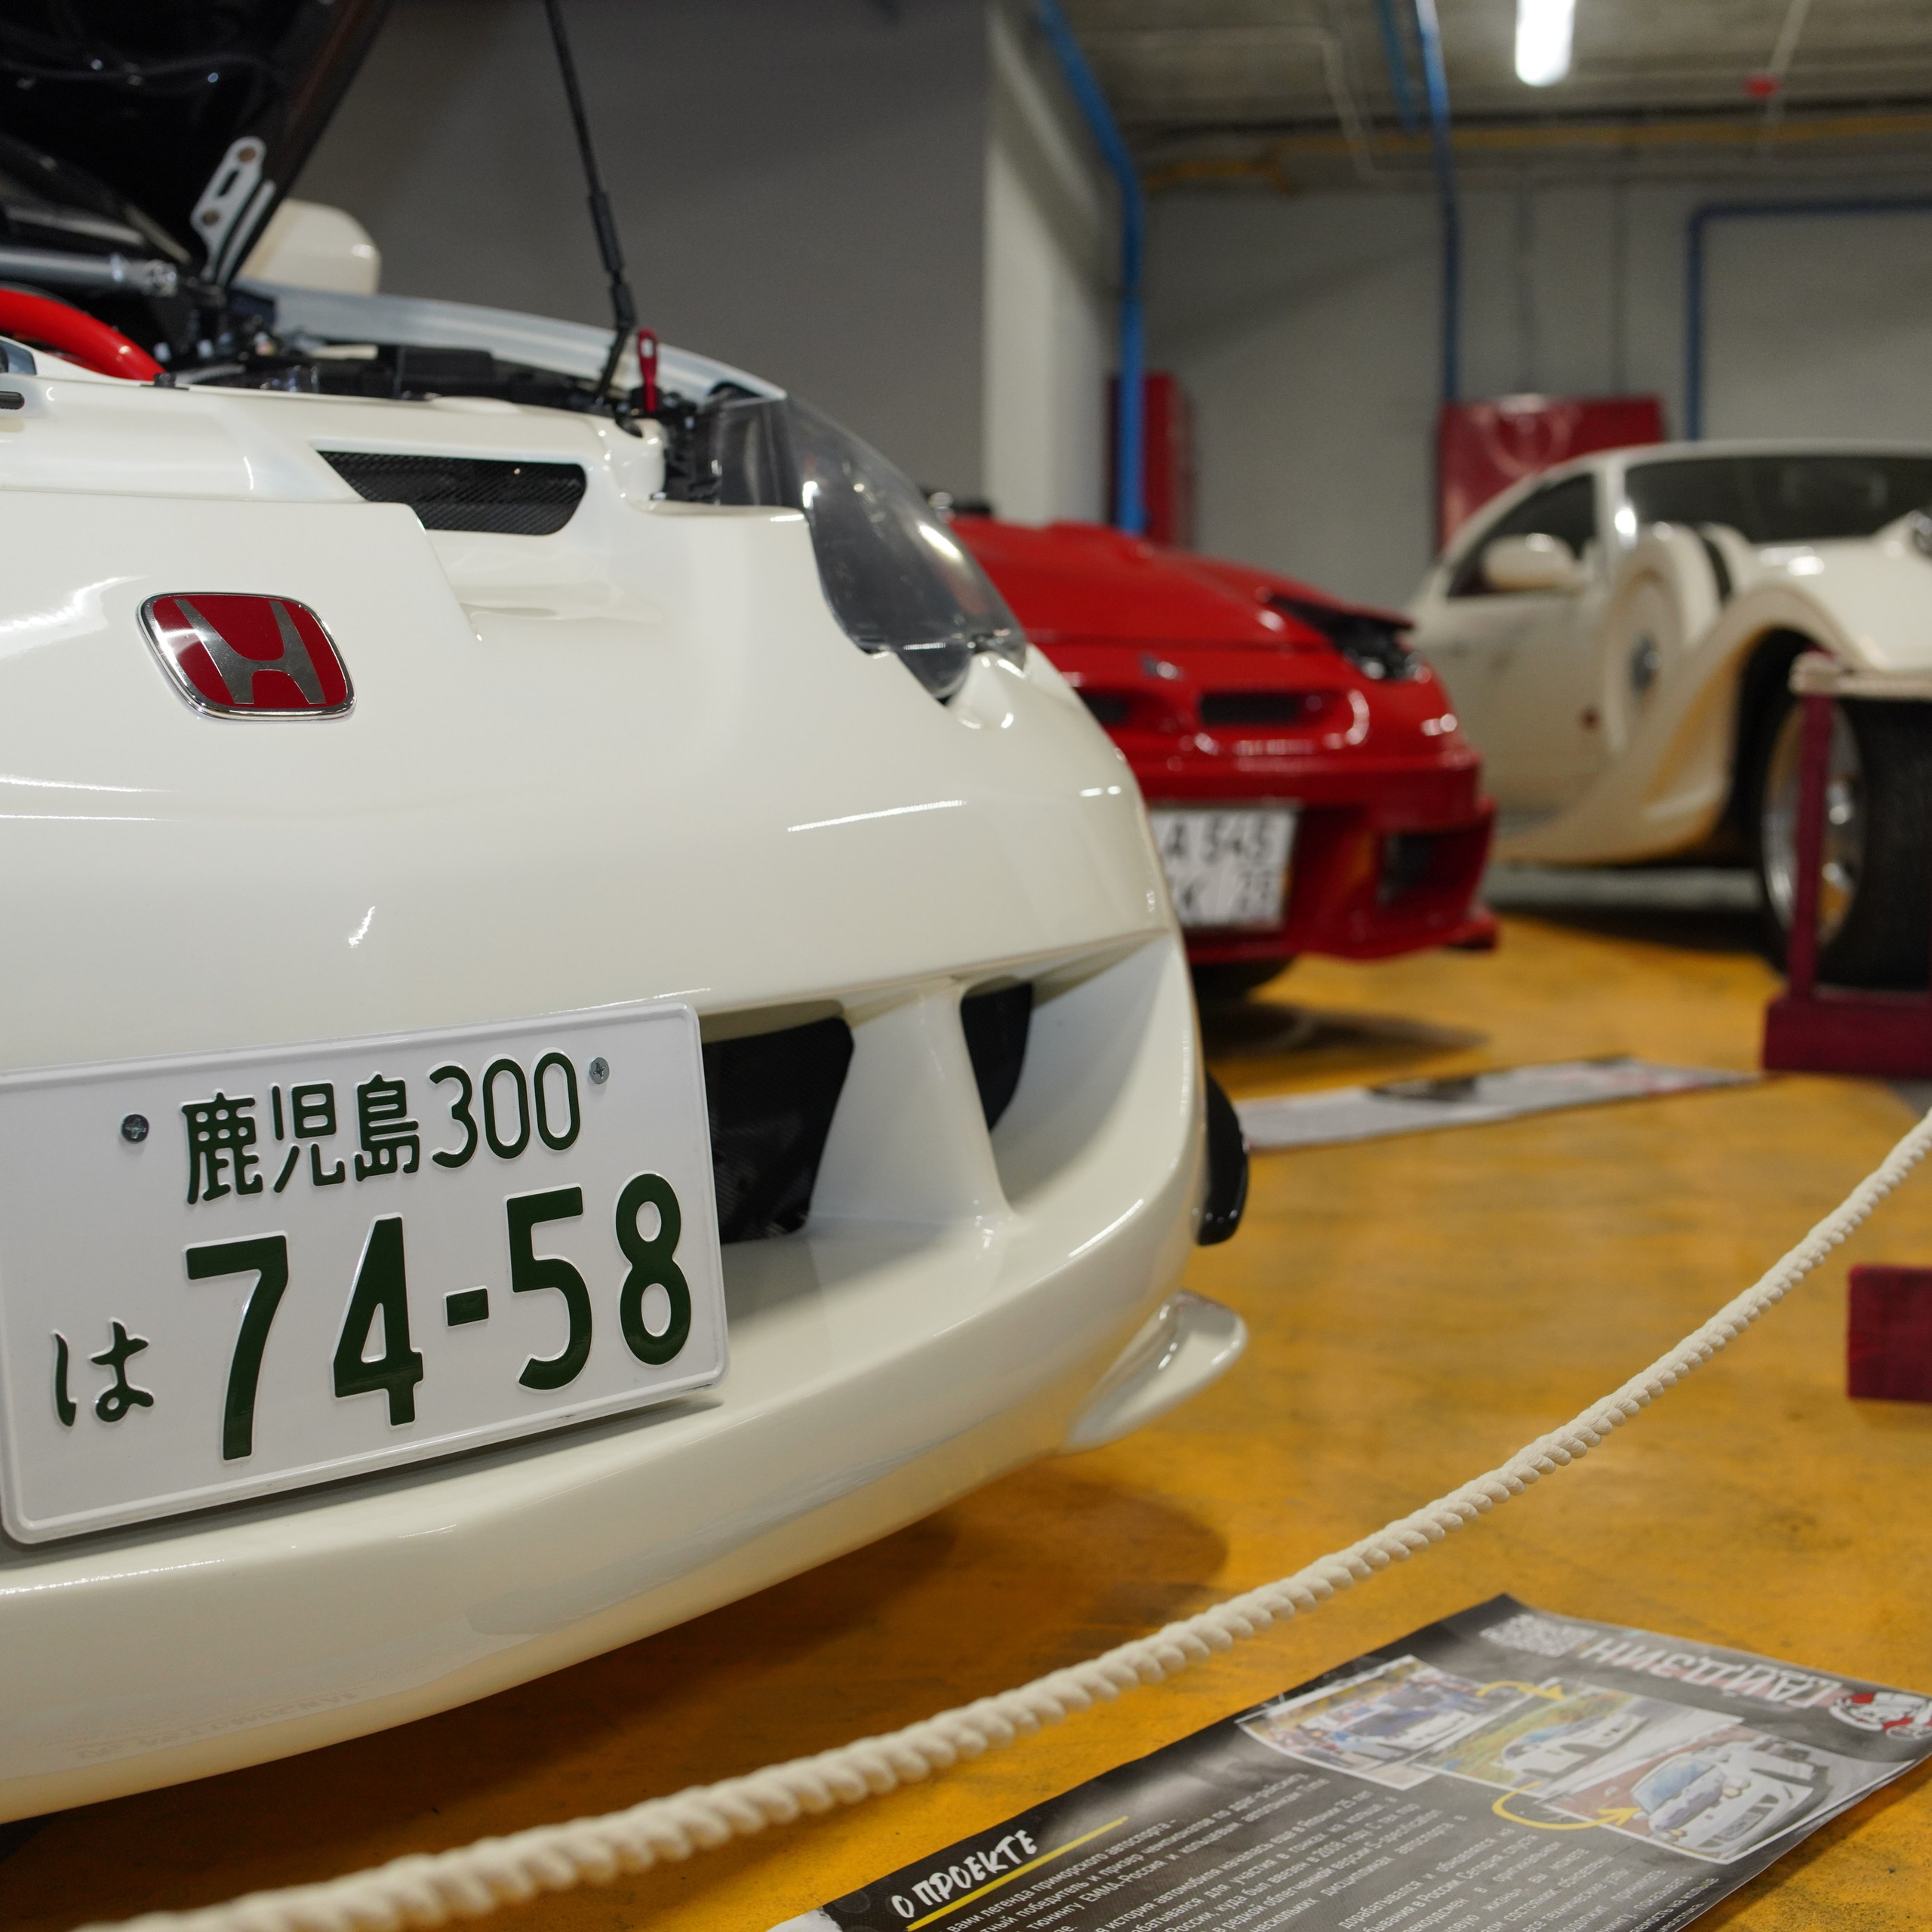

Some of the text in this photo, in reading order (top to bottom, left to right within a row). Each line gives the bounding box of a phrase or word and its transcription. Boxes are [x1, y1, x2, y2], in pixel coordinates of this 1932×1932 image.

[52, 1171, 693, 1463] は 74-58
[891, 1829, 1038, 1918] О ПРОЕКТЕ
[946, 1915, 984, 1932] вами
[980, 1890, 1035, 1917] легенда
[1030, 1854, 1109, 1891] приморского
[1105, 1823, 1171, 1855] автоспорта
[1016, 1882, 1090, 1917] победитель
[1099, 1854, 1144, 1876] призер
[1105, 1903, 1158, 1929] история
[1153, 1869, 1223, 1903] автомобиля
[1220, 1844, 1274, 1870] началась
[1204, 1884, 1230, 1898] для
[1229, 1860, 1278, 1885] участия
[1214, 1896, 1247, 1912] куда
[1241, 1882, 1272, 1896] был
[1267, 1863, 1309, 1884] ввезен
[1221, 1903, 1267, 1930] редкой
[1263, 1867, 1336, 1906] облегченной
[1331, 1847, 1371, 1869] версии
[1320, 1857, 1394, 1897] дисциплинах
[1337, 1881, 1423, 1929] дорабатывался
[1026, 1903, 1085, 1929] тюнингу
